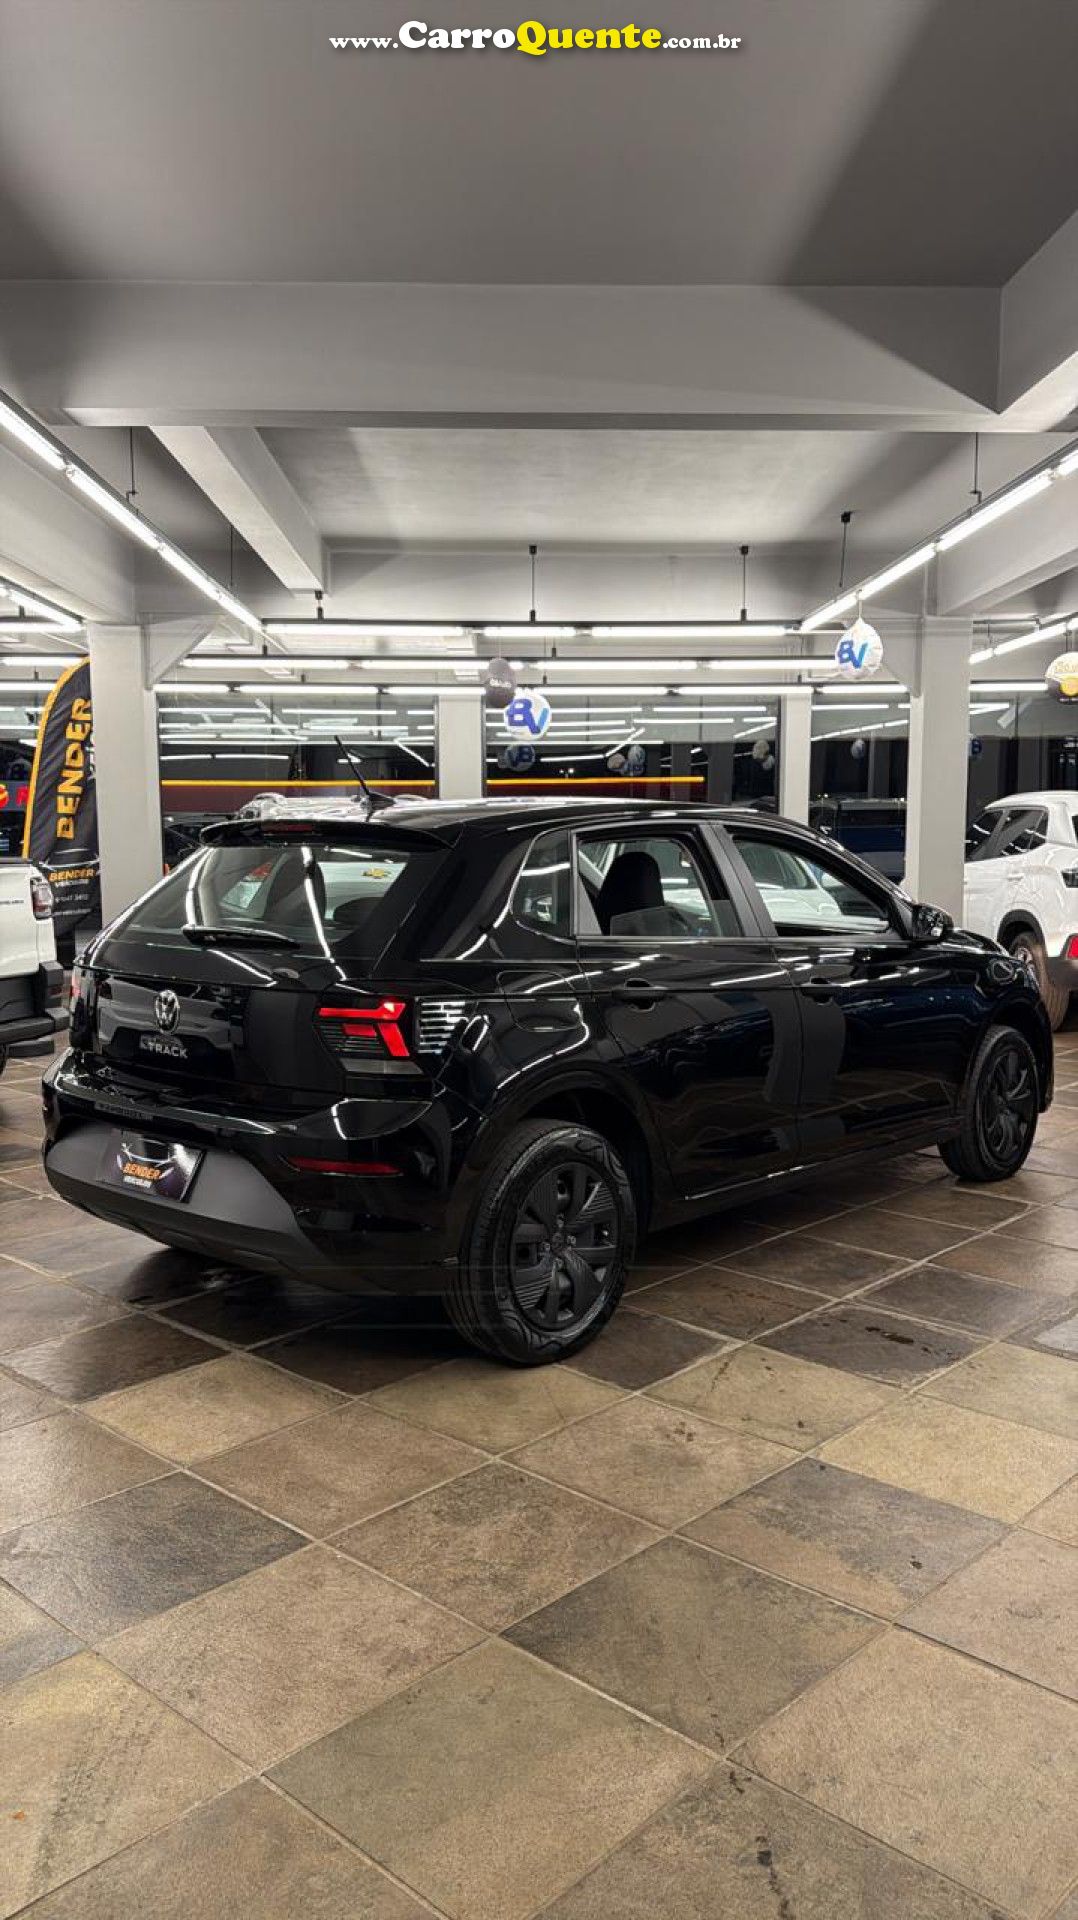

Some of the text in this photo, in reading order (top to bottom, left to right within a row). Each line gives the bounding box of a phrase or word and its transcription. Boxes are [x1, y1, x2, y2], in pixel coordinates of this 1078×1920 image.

[837, 640, 868, 669] BV
[506, 699, 549, 733] BV
[56, 698, 91, 840] BENDER
[148, 1037, 188, 1059] TRACK
